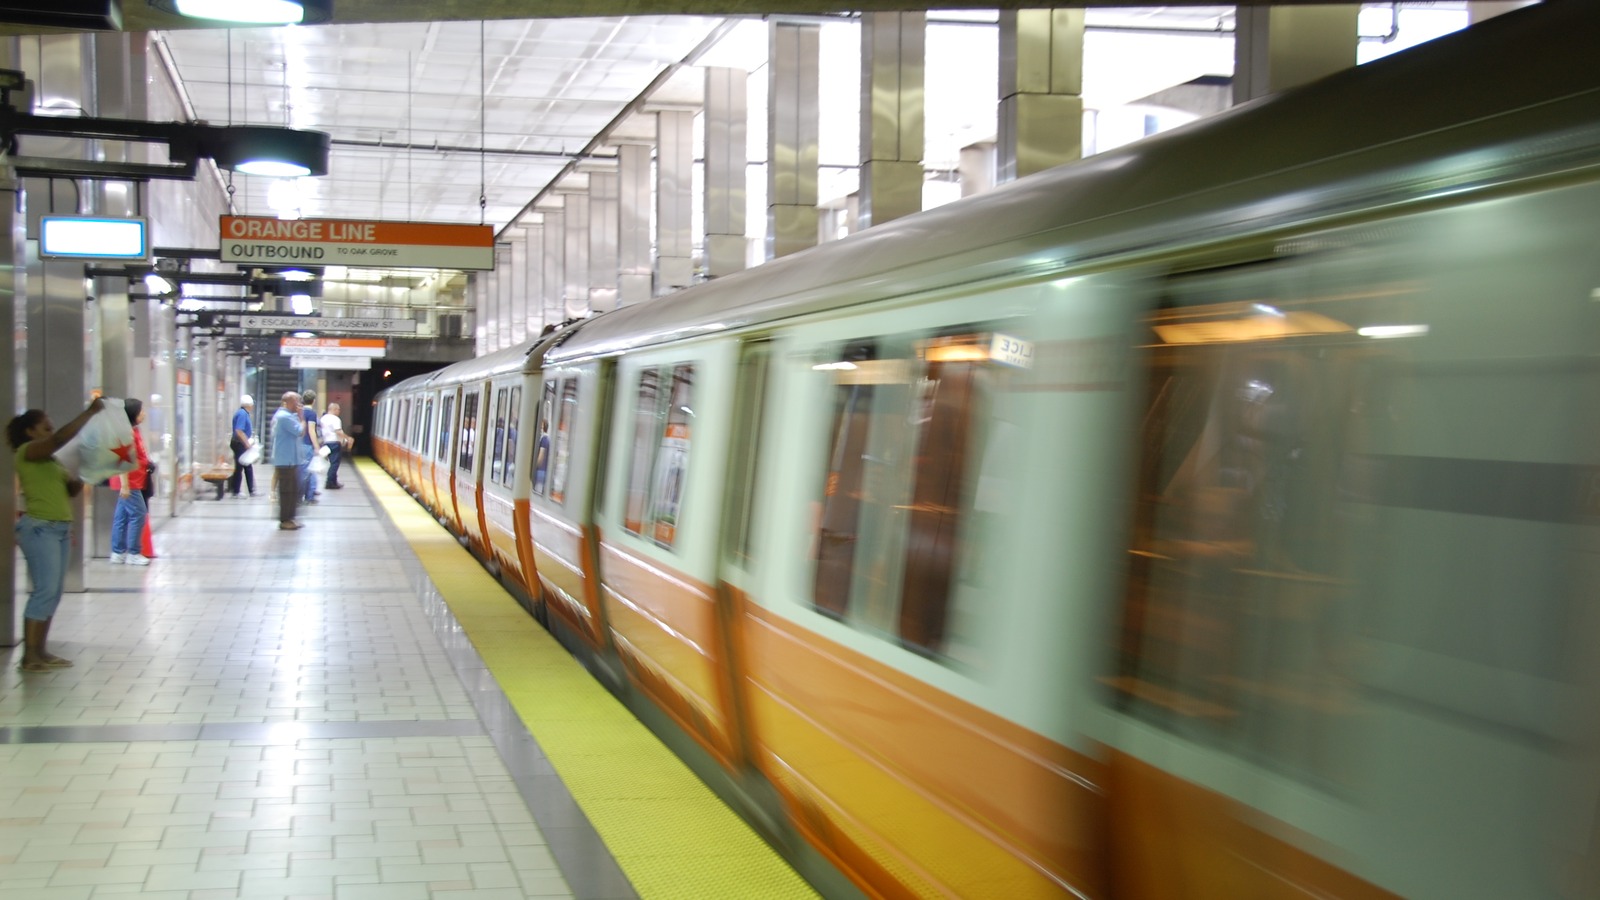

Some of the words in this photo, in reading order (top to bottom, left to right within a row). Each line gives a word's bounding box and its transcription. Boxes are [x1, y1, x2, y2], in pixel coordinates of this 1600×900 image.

[230, 219, 322, 240] ORANGE
[329, 222, 376, 241] LINE
[231, 244, 324, 259] OUTBOUND
[337, 247, 348, 255] TO
[350, 248, 368, 256] OAK
[370, 248, 398, 256] GROVE
[318, 319, 329, 328] TO
[331, 320, 379, 328] CAUSEWAY
